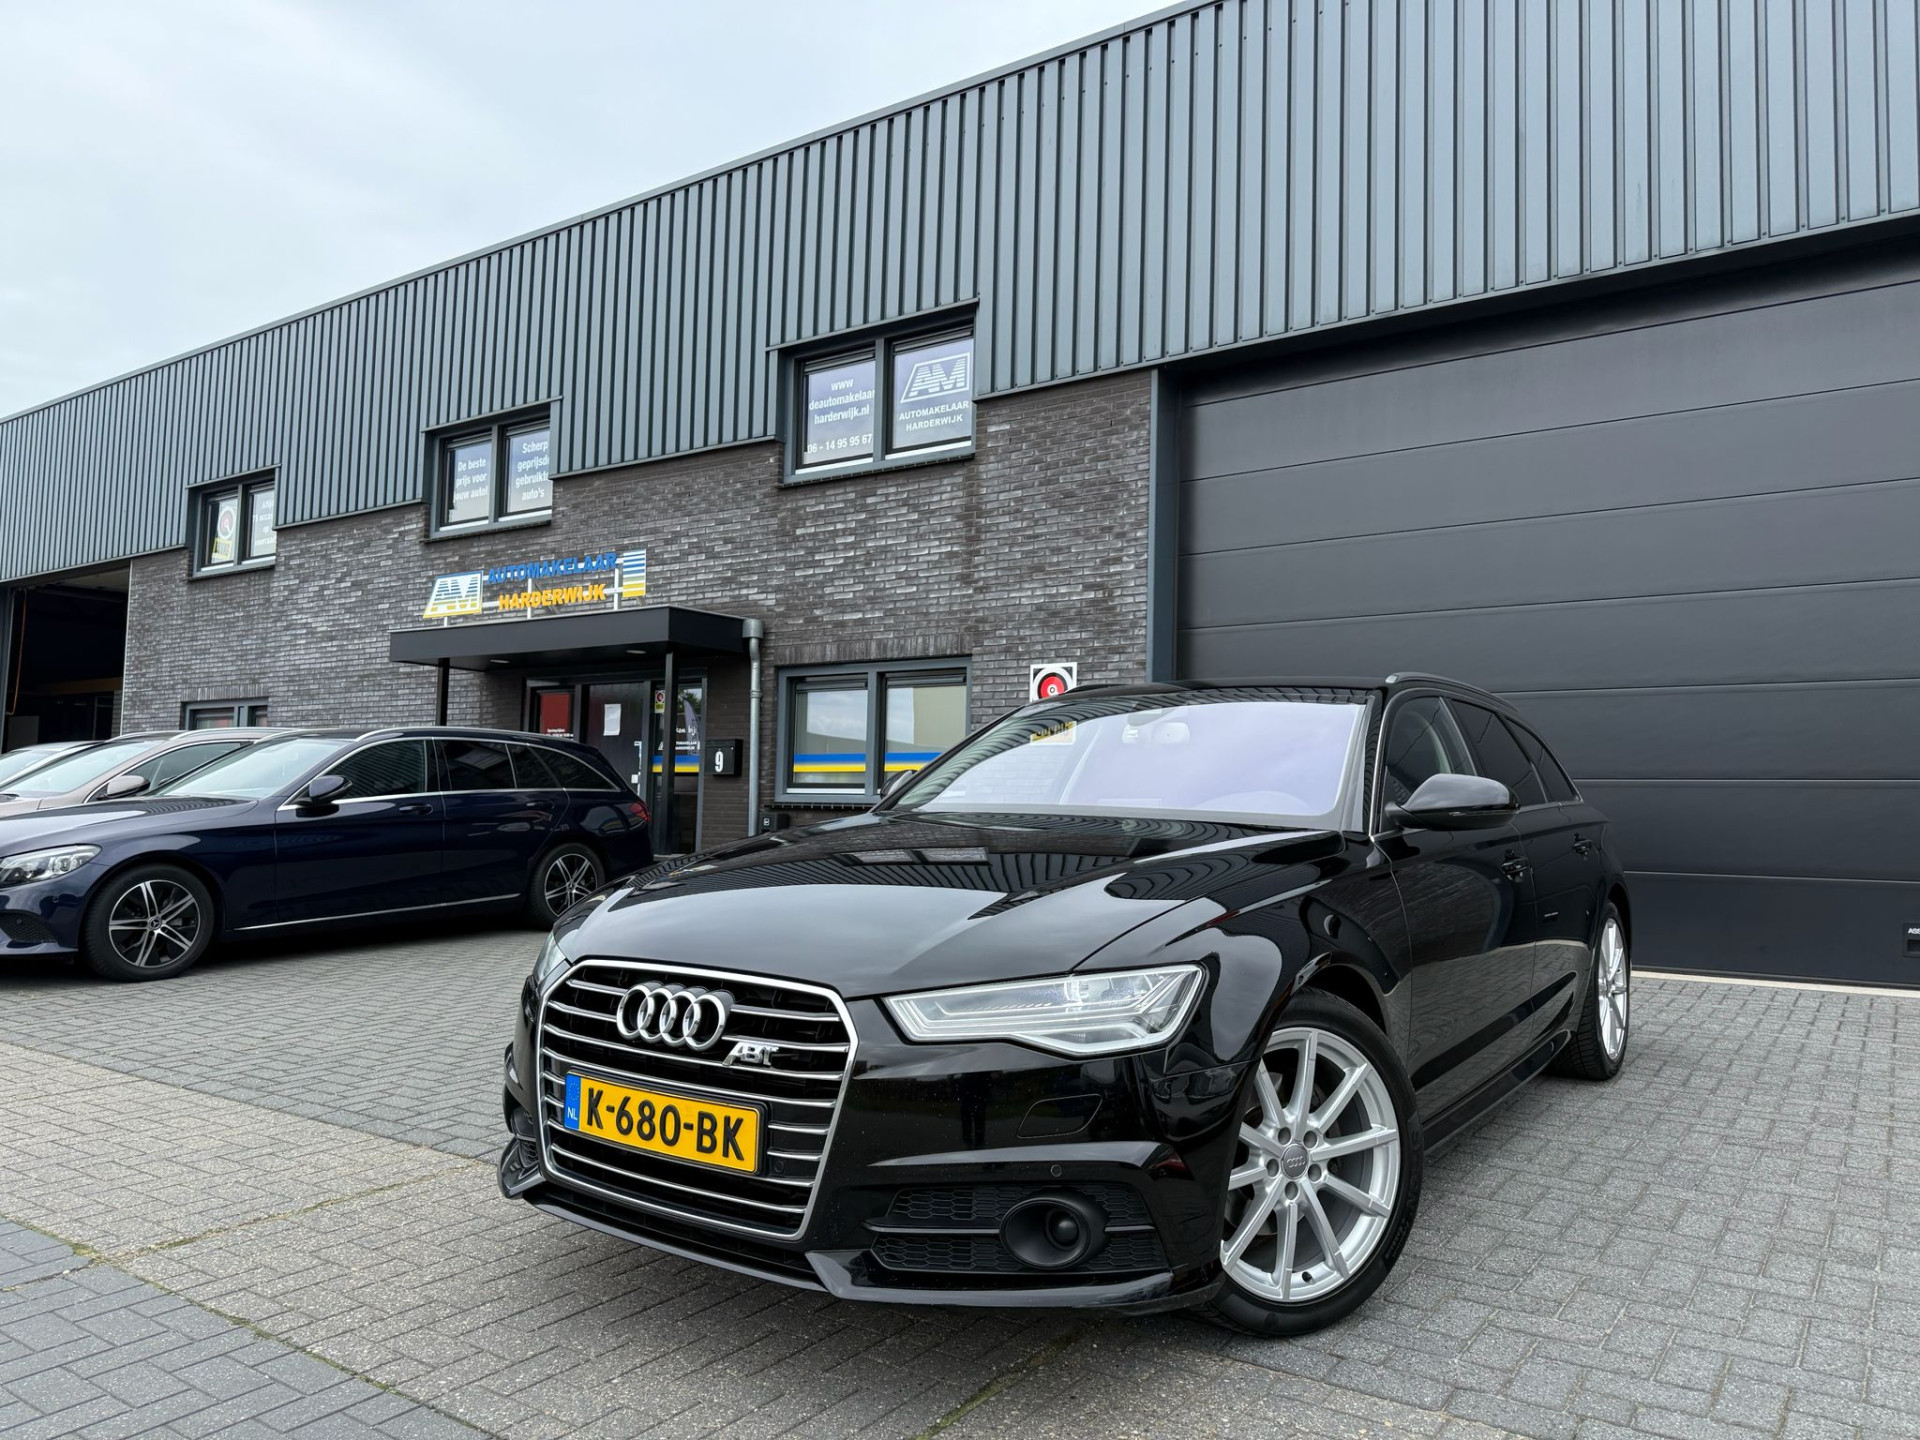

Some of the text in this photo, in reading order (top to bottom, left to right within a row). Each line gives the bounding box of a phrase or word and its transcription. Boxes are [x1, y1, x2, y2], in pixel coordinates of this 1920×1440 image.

[831, 378, 854, 392] www
[808, 390, 875, 411] deautomakelaar
[899, 400, 969, 421] AUTOMAKELAAR
[814, 404, 870, 425] harderwijk.nl
[905, 413, 963, 432] HARDERWIJK
[522, 441, 549, 454] Scherp
[825, 438, 836, 451] 14
[837, 436, 848, 449] 95
[849, 435, 860, 447] 95
[861, 433, 873, 445] 67
[458, 457, 487, 471] De beste
[456, 473, 487, 488] prijs voor
[522, 488, 545, 500] auto's
[486, 551, 618, 585] AUTOMAKELAAR
[498, 583, 607, 611] HARDERWIJK
[714, 750, 724, 773] 9
[722, 1041, 780, 1067] ABT
[567, 1106, 578, 1121] NL
[586, 1086, 745, 1162] K-680-BK
